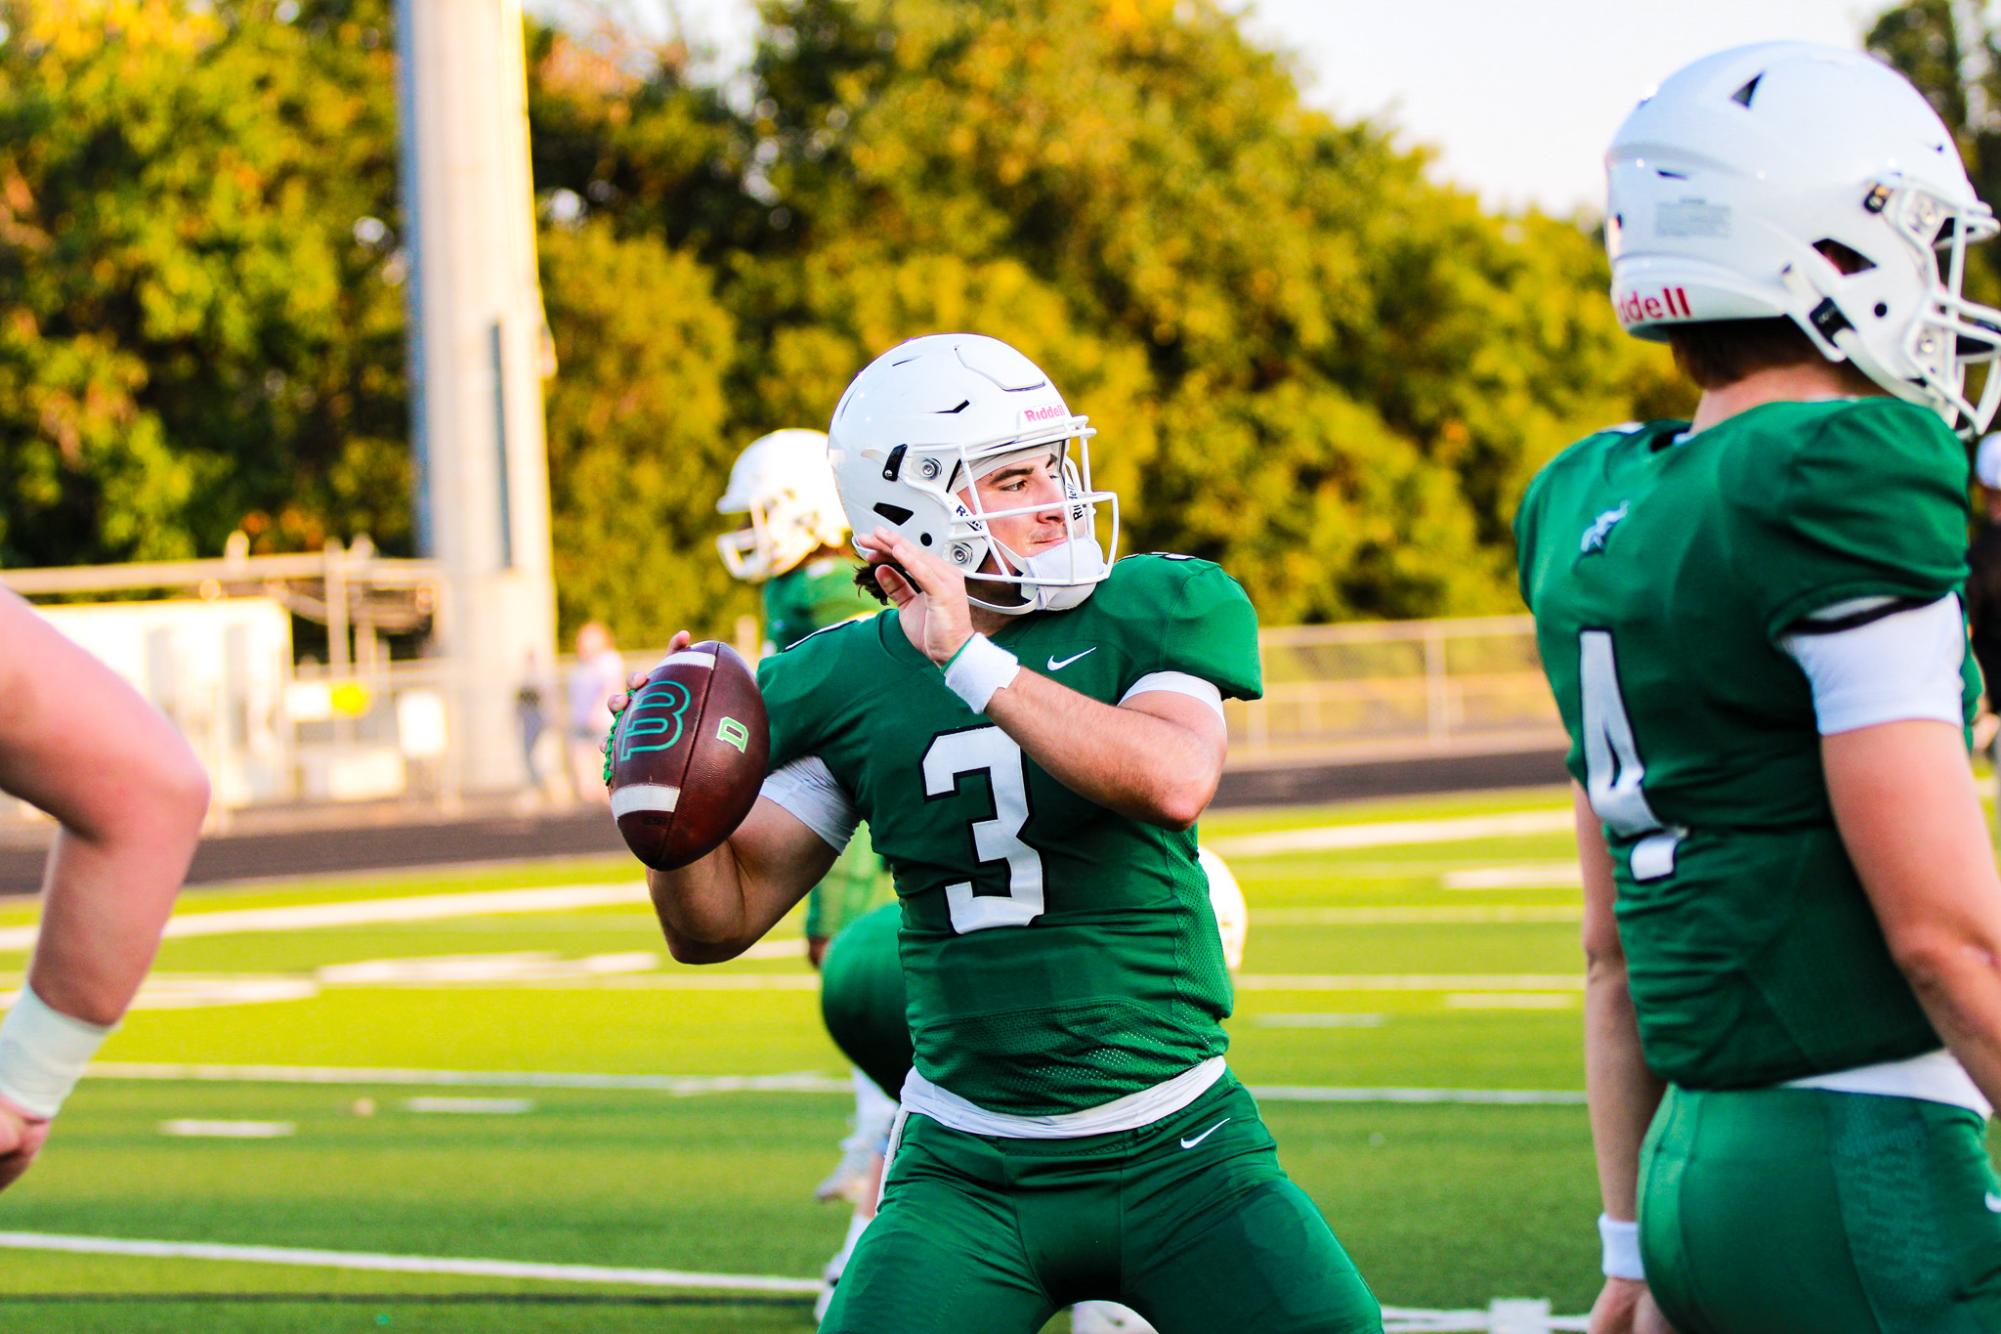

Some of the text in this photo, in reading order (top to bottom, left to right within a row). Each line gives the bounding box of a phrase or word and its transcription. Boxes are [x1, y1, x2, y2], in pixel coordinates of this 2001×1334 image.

[1024, 404, 1066, 422] Riddell
[922, 725, 1044, 934] 3
[1580, 630, 1689, 880] 4
